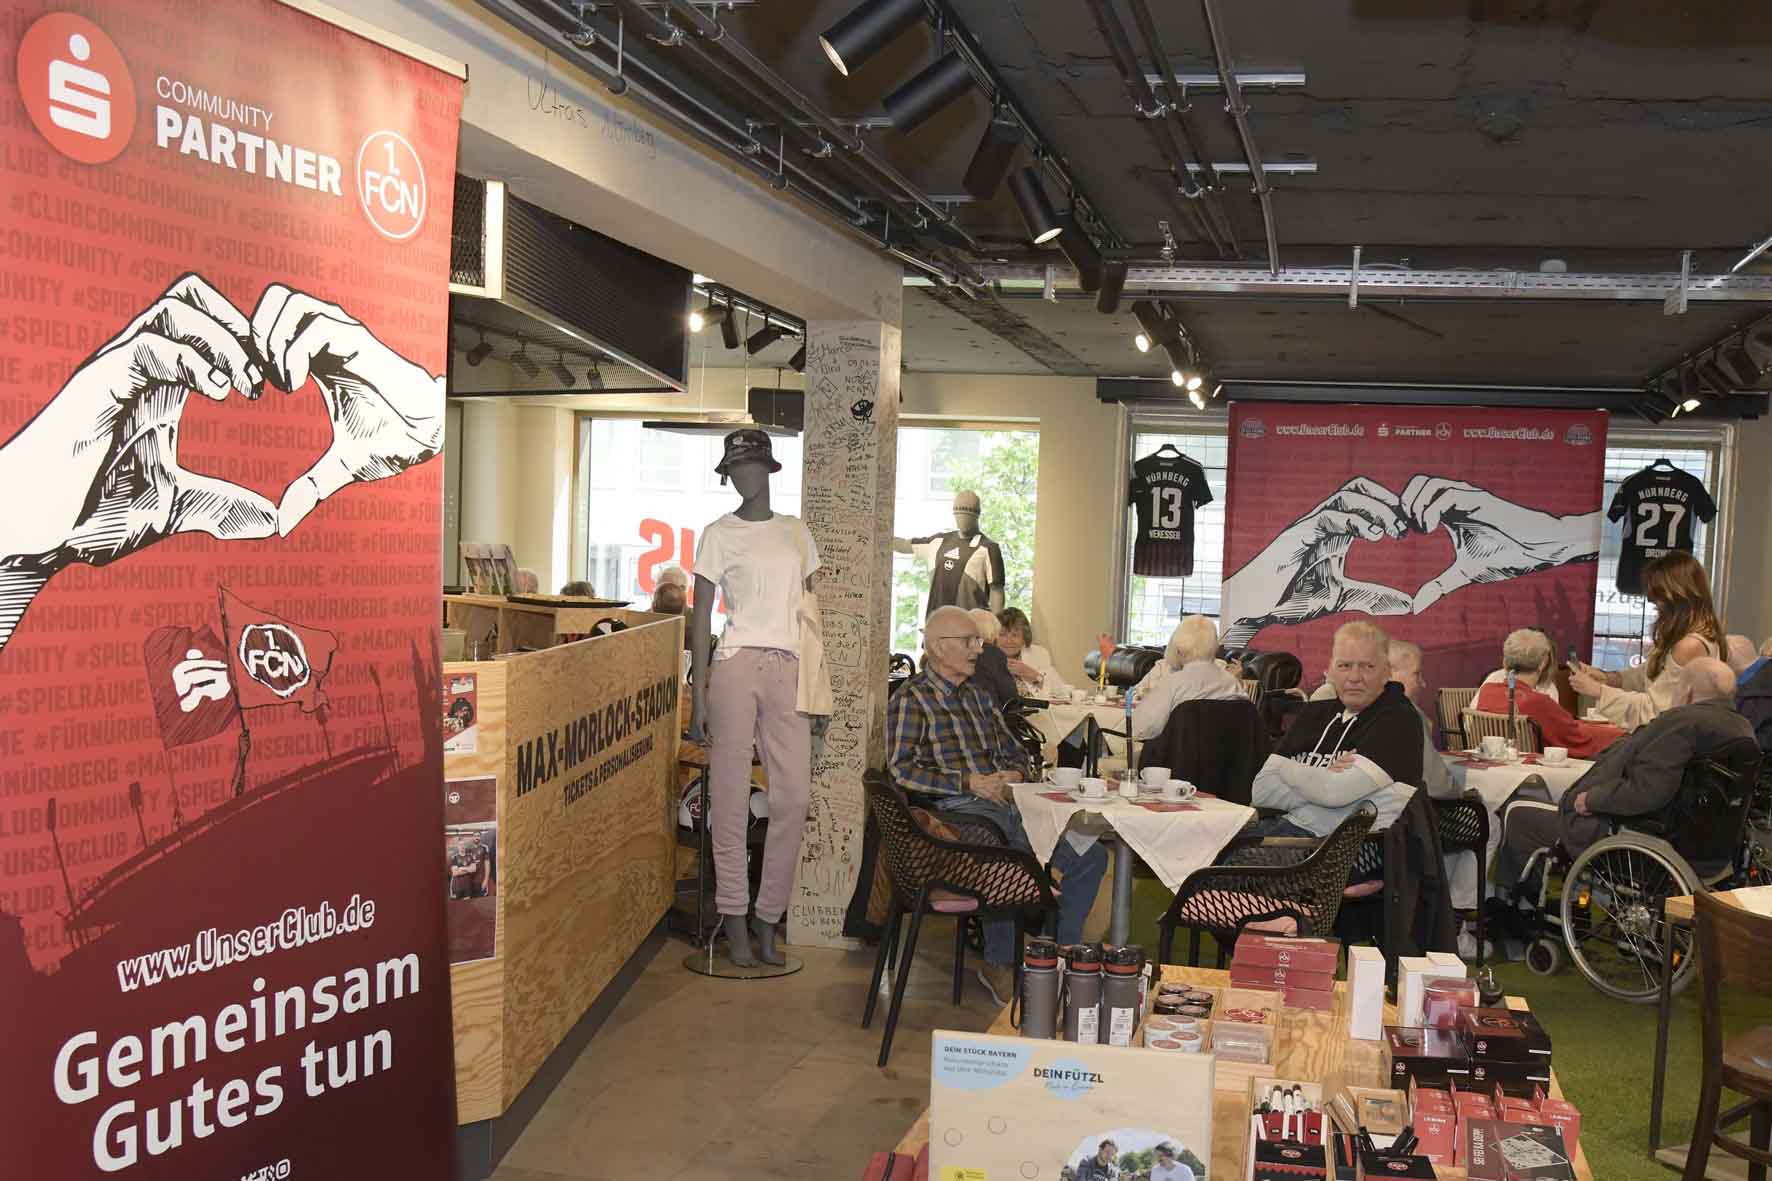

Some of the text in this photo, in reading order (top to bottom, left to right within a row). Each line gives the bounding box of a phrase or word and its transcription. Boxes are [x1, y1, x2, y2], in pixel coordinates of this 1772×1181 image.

[156, 76, 273, 129] COMMUNITY
[157, 104, 343, 196] PARTNER
[364, 170, 418, 219] FCN
[1151, 486, 1182, 529] 13
[1636, 502, 1686, 547] 27
[248, 650, 304, 678] FCN
[517, 673, 679, 798] MAX-MORLOCK-STADION
[564, 771, 593, 808] TICKETS
[116, 894, 375, 992] www.UnserClub.de
[53, 952, 420, 1105] Gemeinsam
[943, 1046, 962, 1054] DEIN
[93, 1027, 393, 1173] Gutes tun
